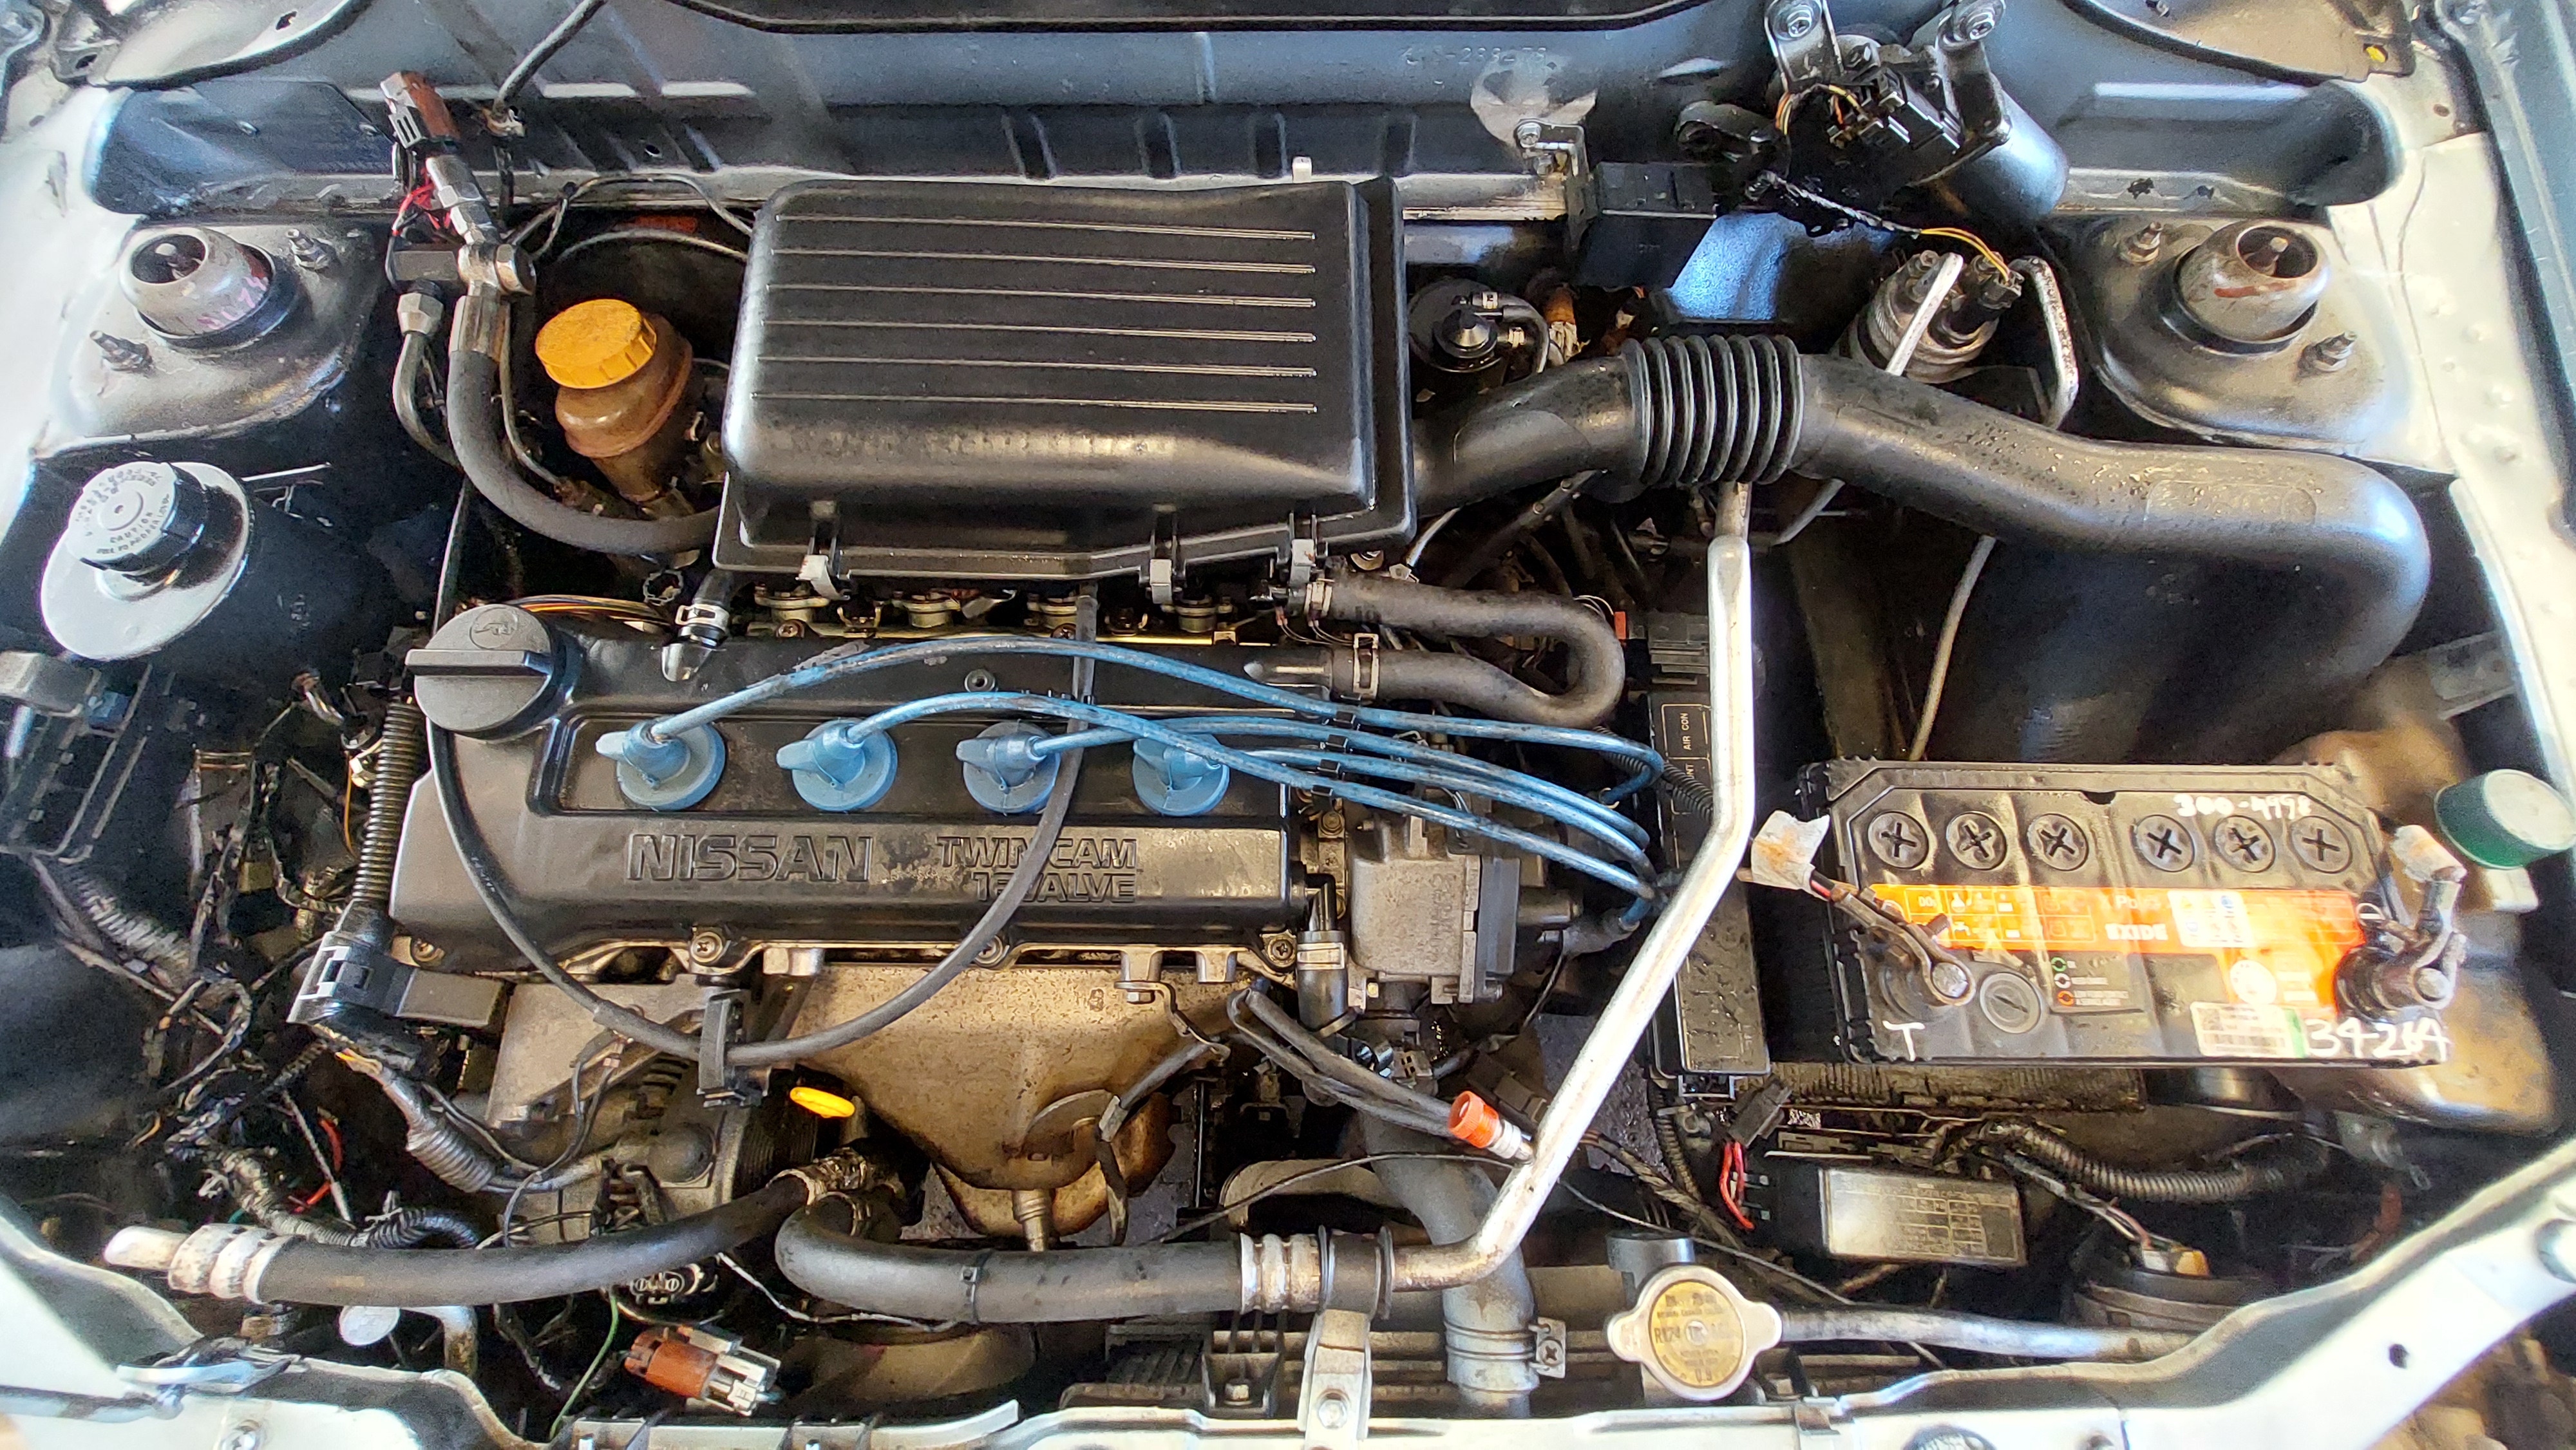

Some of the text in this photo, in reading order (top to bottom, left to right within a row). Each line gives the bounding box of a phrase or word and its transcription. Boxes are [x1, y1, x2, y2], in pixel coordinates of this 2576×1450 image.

[109, 512, 153, 543] CAUTION
[1680, 713, 1692, 750] AIR CON
[626, 833, 874, 881] NISSAN
[1048, 837, 1137, 869] CAM
[2105, 923, 2169, 941] EXIDE
[1882, 1020, 1926, 1062] T
